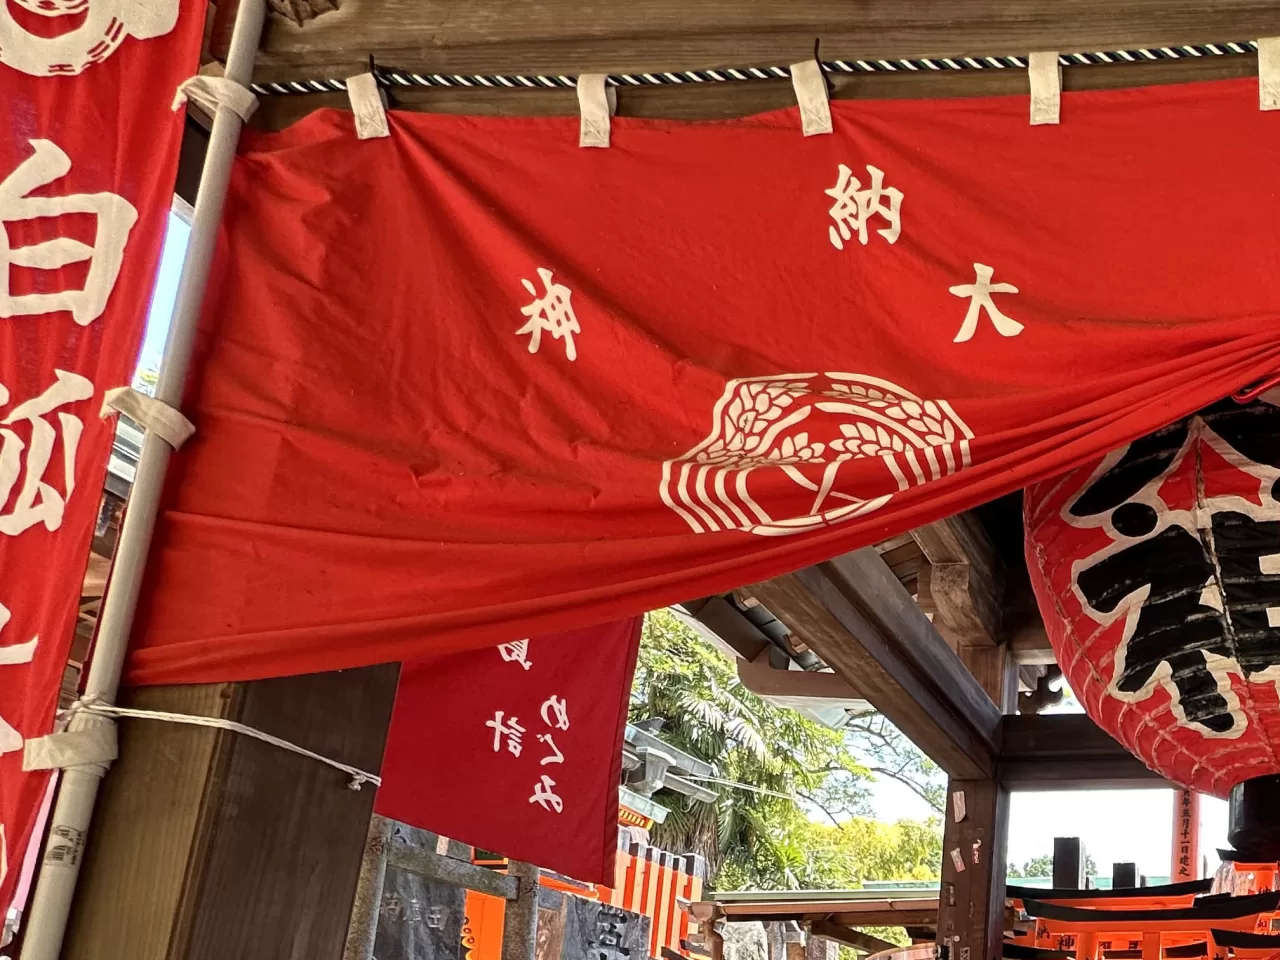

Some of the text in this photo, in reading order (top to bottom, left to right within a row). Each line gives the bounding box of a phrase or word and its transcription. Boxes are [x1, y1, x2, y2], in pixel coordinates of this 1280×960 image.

[824, 163, 904, 250] 納
[515, 267, 580, 361] 神
[948, 262, 1025, 344] 大
